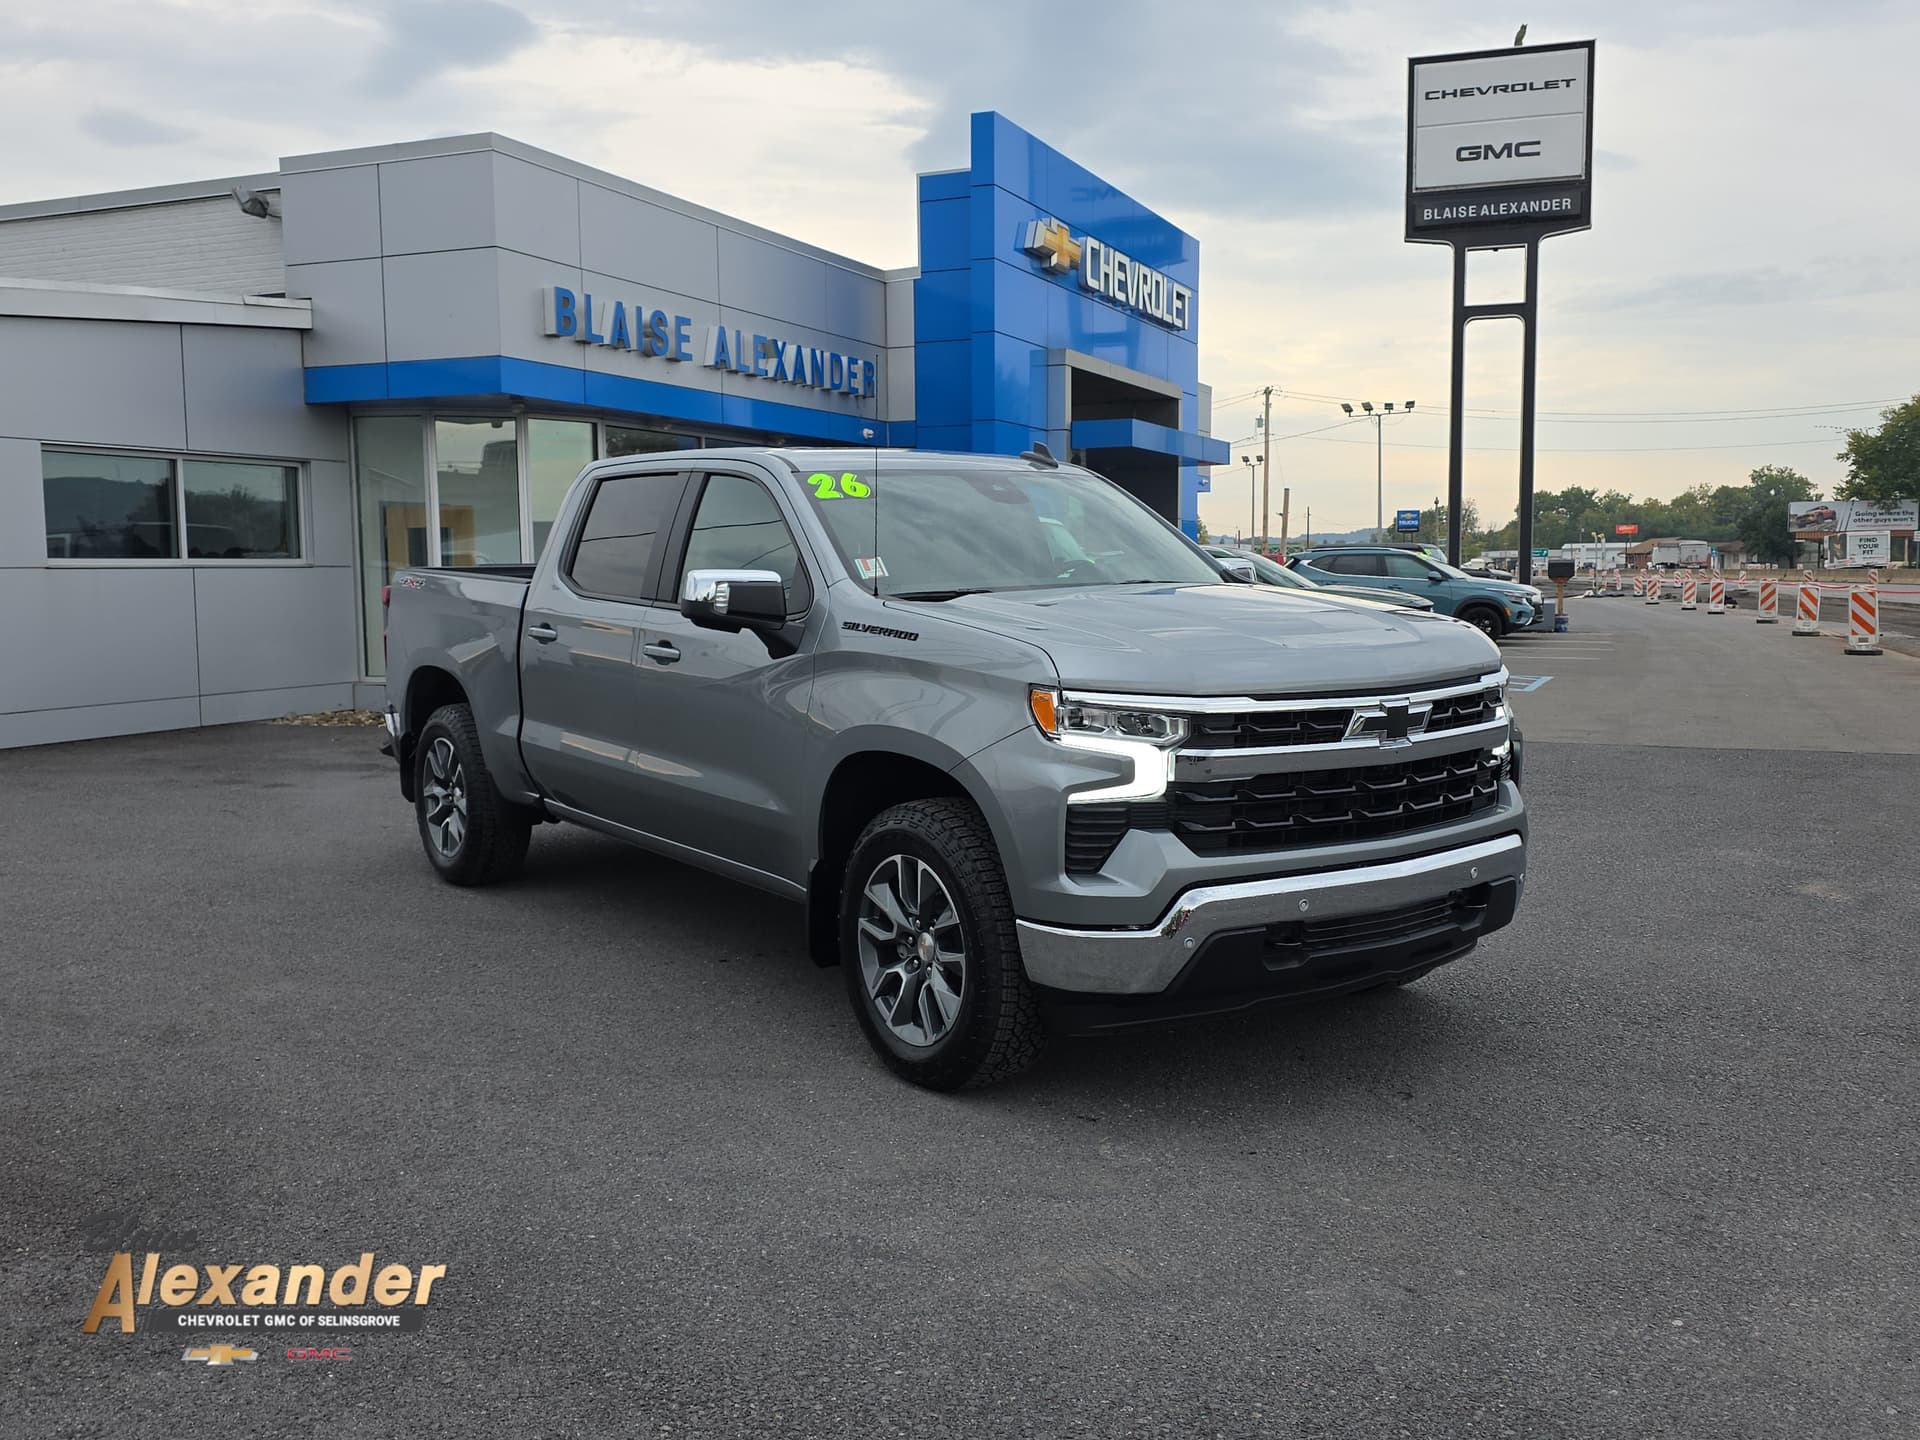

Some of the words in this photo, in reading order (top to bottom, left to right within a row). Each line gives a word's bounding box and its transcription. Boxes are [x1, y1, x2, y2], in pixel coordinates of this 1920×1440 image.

[1424, 78, 1577, 101] CHEVROLET
[1455, 140, 1542, 162] GMC
[1423, 205, 1477, 221] BLAISE
[1480, 198, 1572, 217] ALEXANDER
[1082, 235, 1192, 331] CHEVROLET
[549, 286, 693, 362] BLAISE
[709, 325, 876, 399] ALEXANDER
[807, 472, 871, 499] 26
[841, 621, 920, 642] SILVERADO
